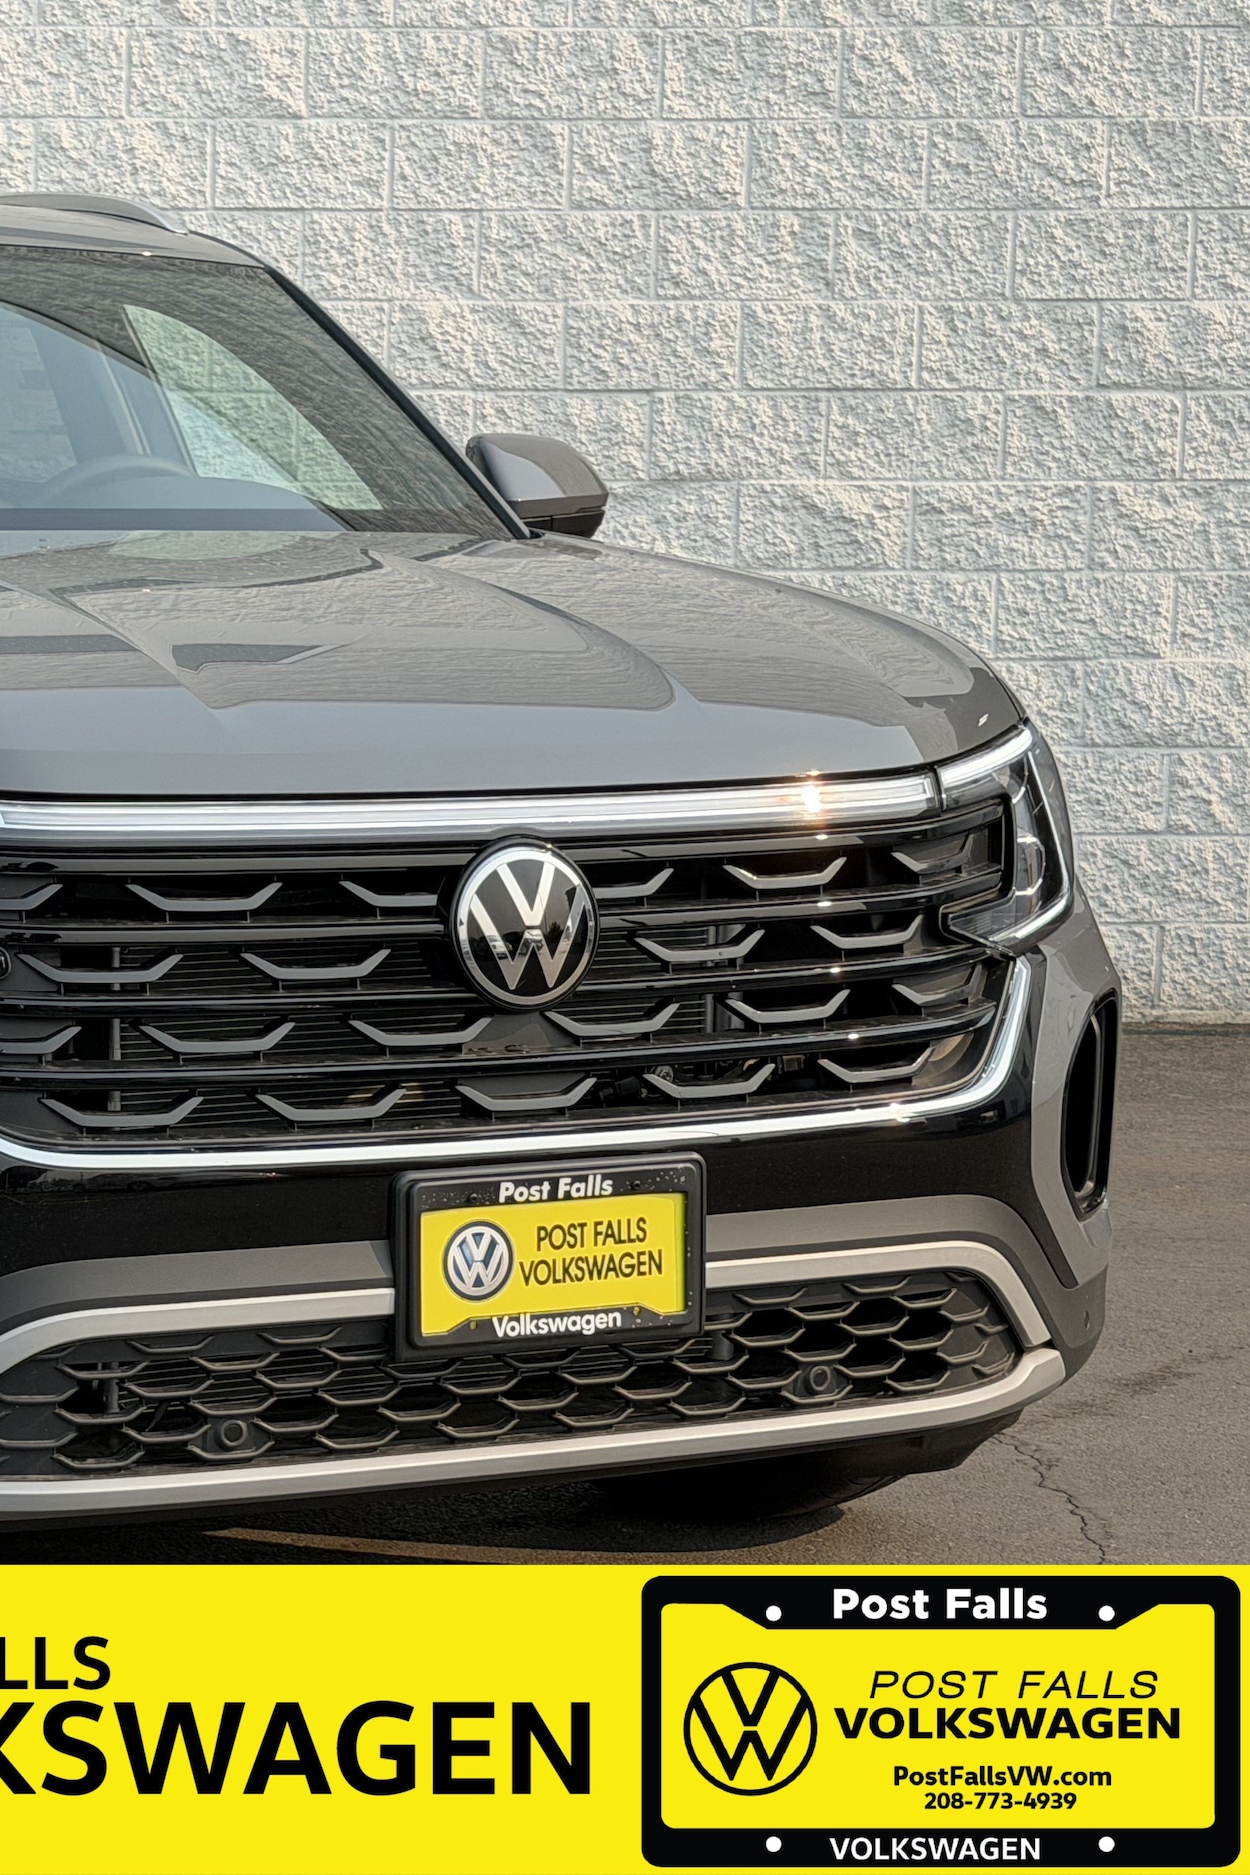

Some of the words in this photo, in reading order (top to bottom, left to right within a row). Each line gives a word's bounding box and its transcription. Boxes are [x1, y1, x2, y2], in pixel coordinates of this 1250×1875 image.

[458, 847, 595, 1004] VW
[498, 1180, 551, 1204] Post
[557, 1174, 614, 1199] Falls
[536, 1222, 586, 1252] POST
[593, 1216, 648, 1246] FALLS
[447, 1224, 509, 1298] VW
[518, 1249, 663, 1287] VOLKSWAGEN
[491, 1311, 622, 1338] Volkswagen
